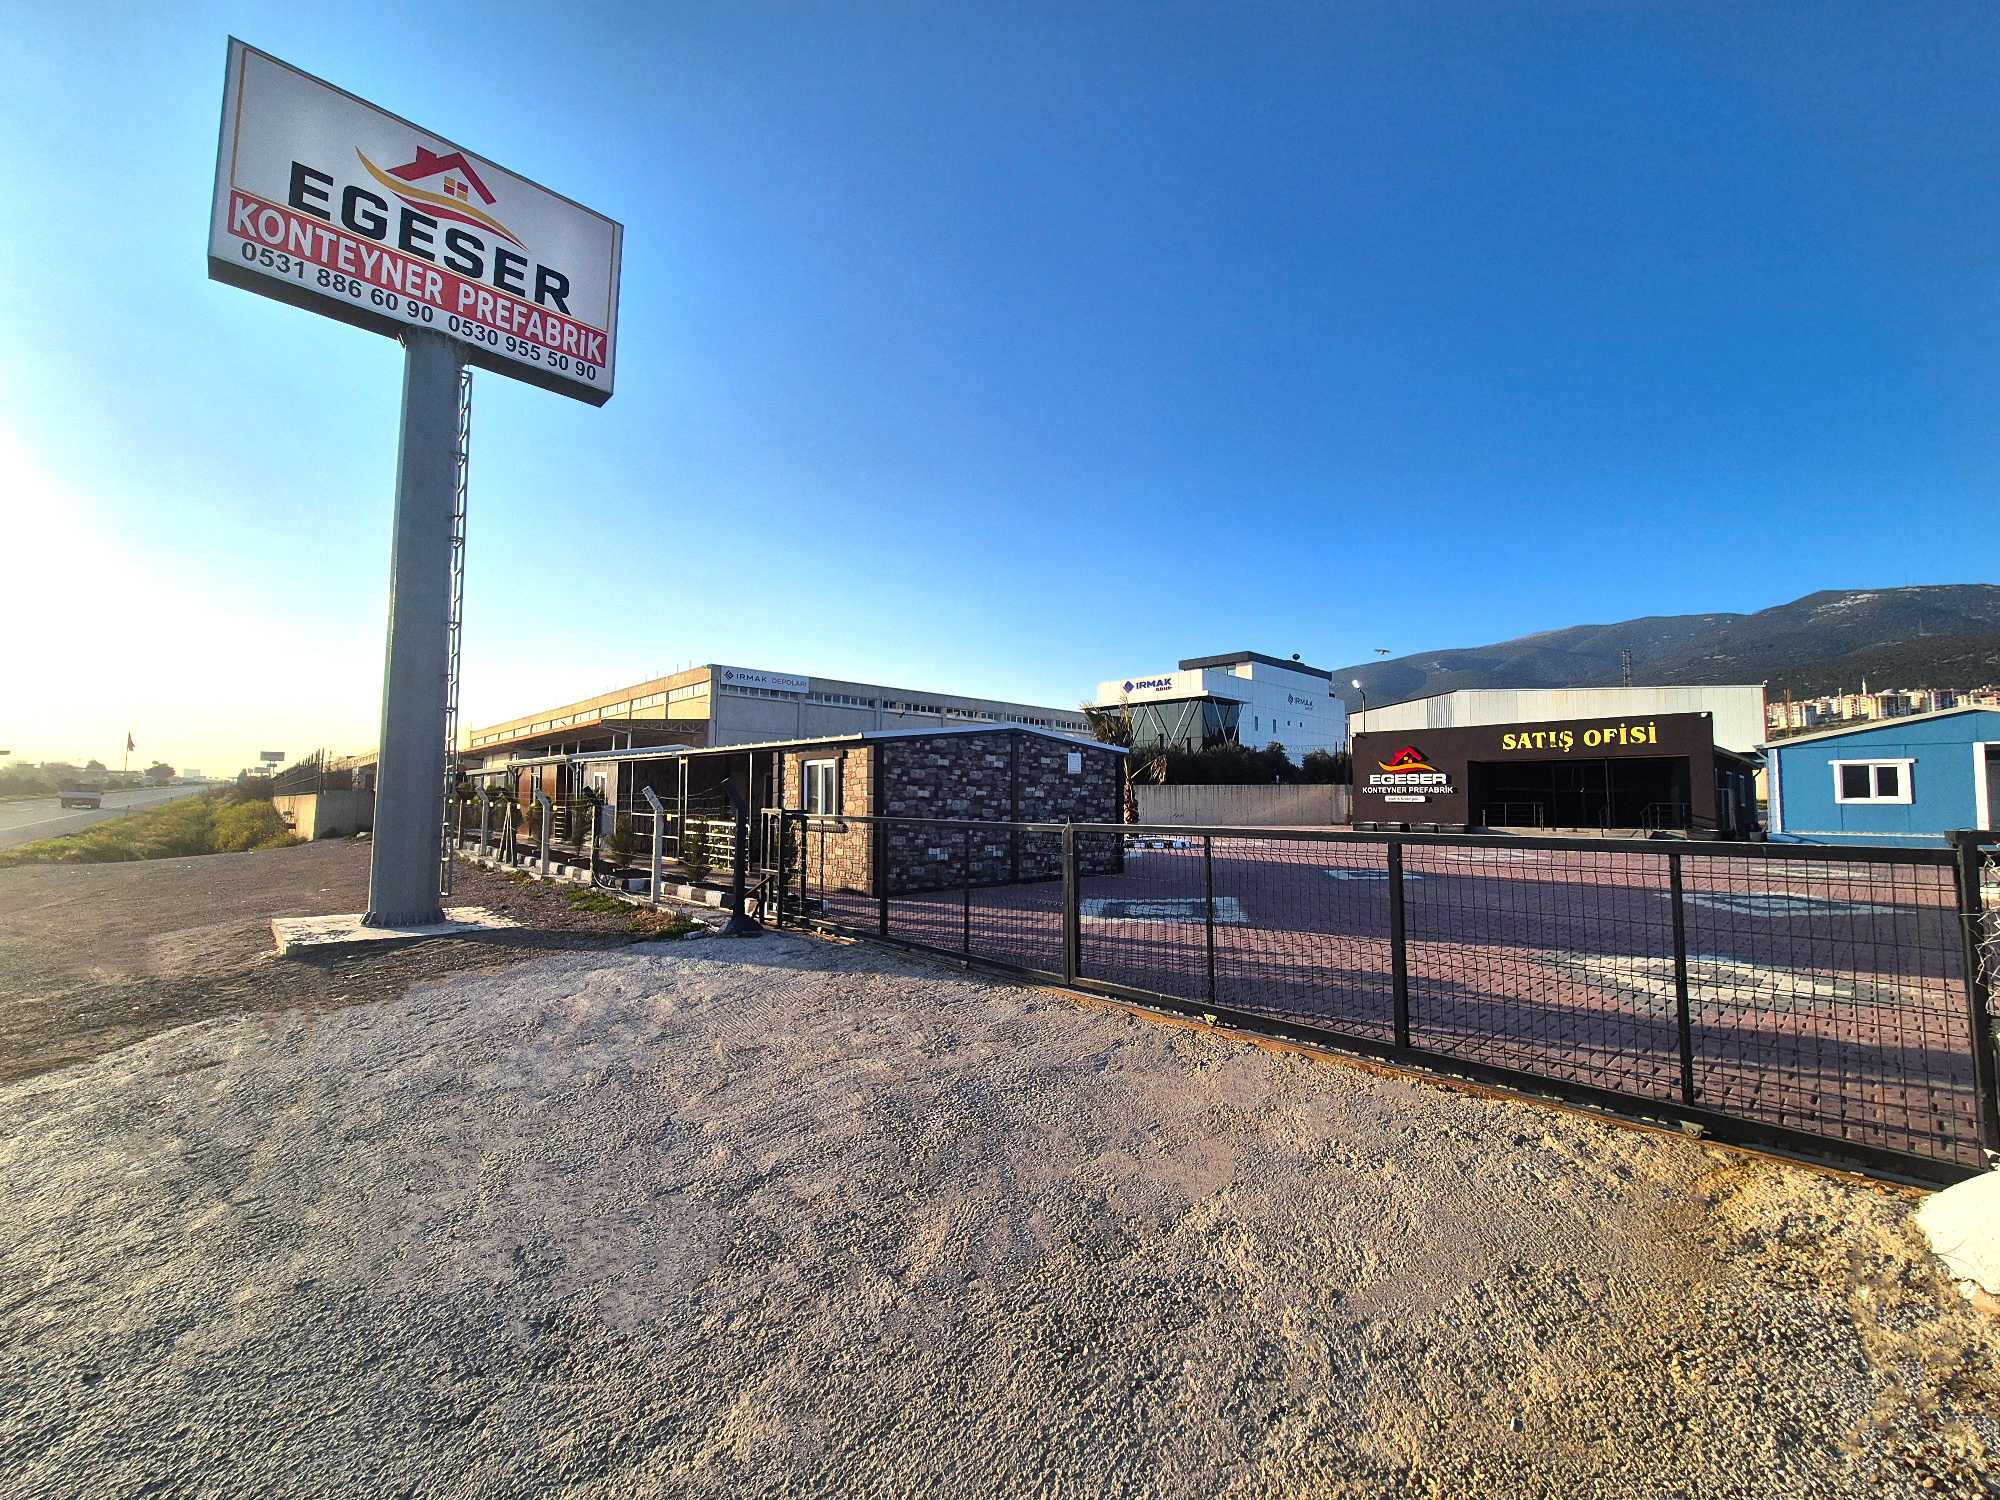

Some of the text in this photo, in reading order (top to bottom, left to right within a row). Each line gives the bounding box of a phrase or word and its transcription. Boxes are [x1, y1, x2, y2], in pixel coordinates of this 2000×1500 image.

[288, 161, 571, 316] EGESER
[233, 198, 443, 304] KONTEYNER
[241, 242, 596, 380] 0531 886 60 90 0530 955 50 90
[736, 673, 767, 682] IRMAK
[1136, 678, 1172, 689] IRMAK
[1502, 721, 1658, 752] SATIŞ OFİSİ
[1362, 785, 1453, 794] KONTEYNER PREFABRİK
[1369, 773, 1447, 785] EGESER
